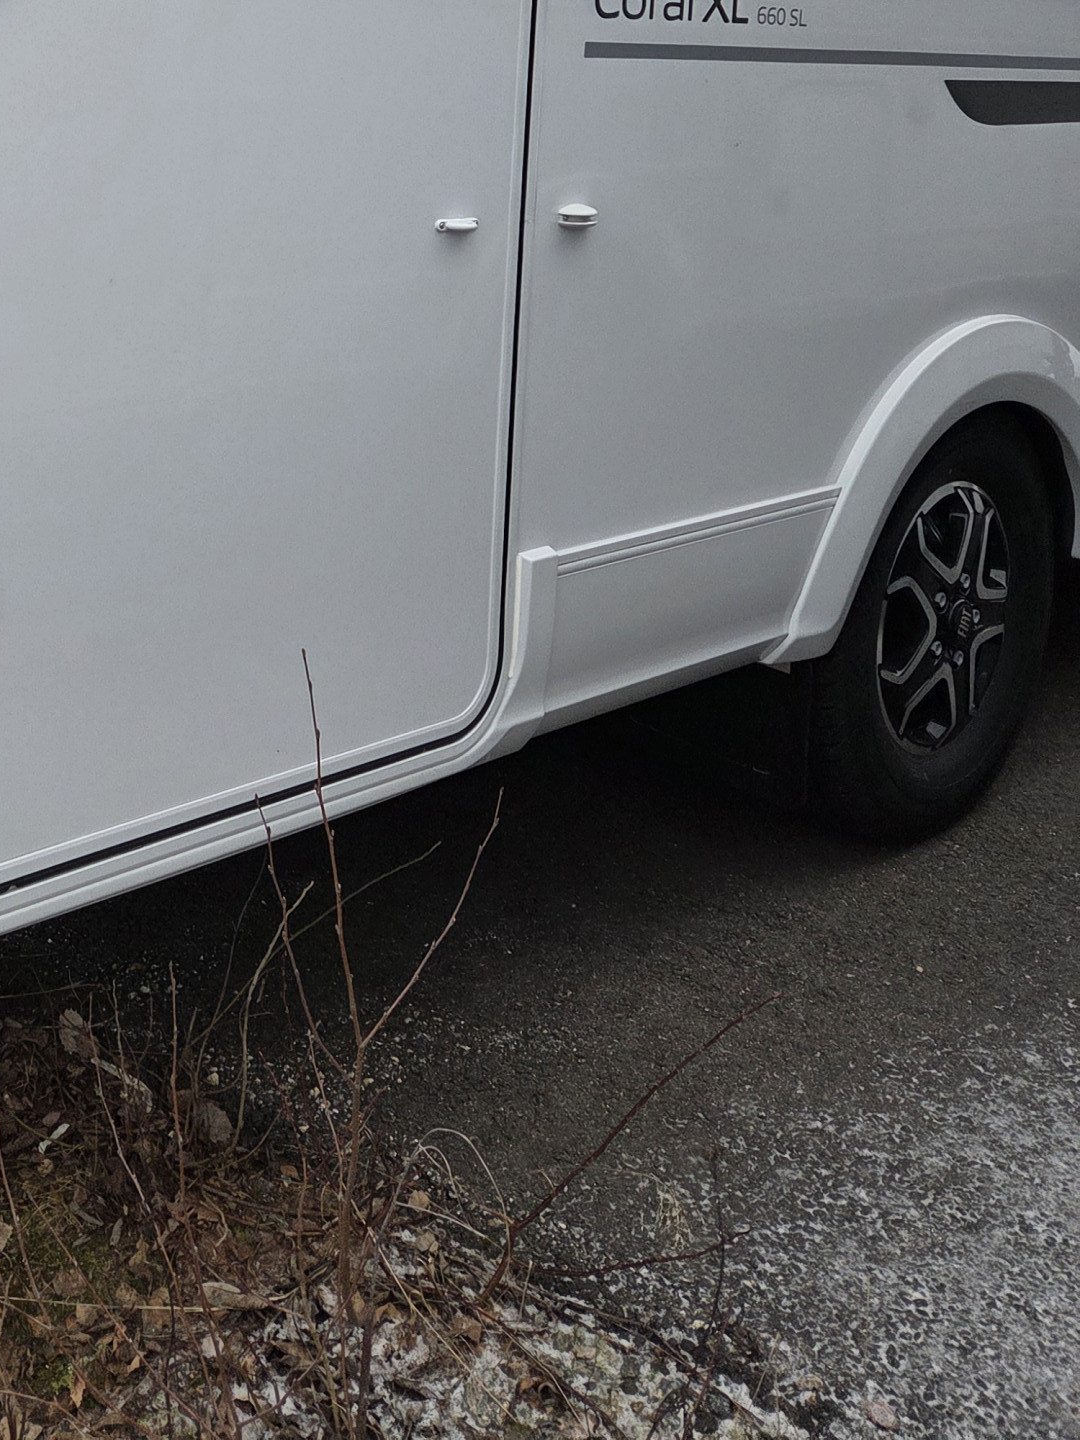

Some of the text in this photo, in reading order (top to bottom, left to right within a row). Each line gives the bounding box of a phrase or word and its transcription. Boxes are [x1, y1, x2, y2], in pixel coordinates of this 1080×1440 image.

[757, 6, 787, 25] 660
[789, 8, 808, 27] SL
[957, 607, 971, 638] FIAT
